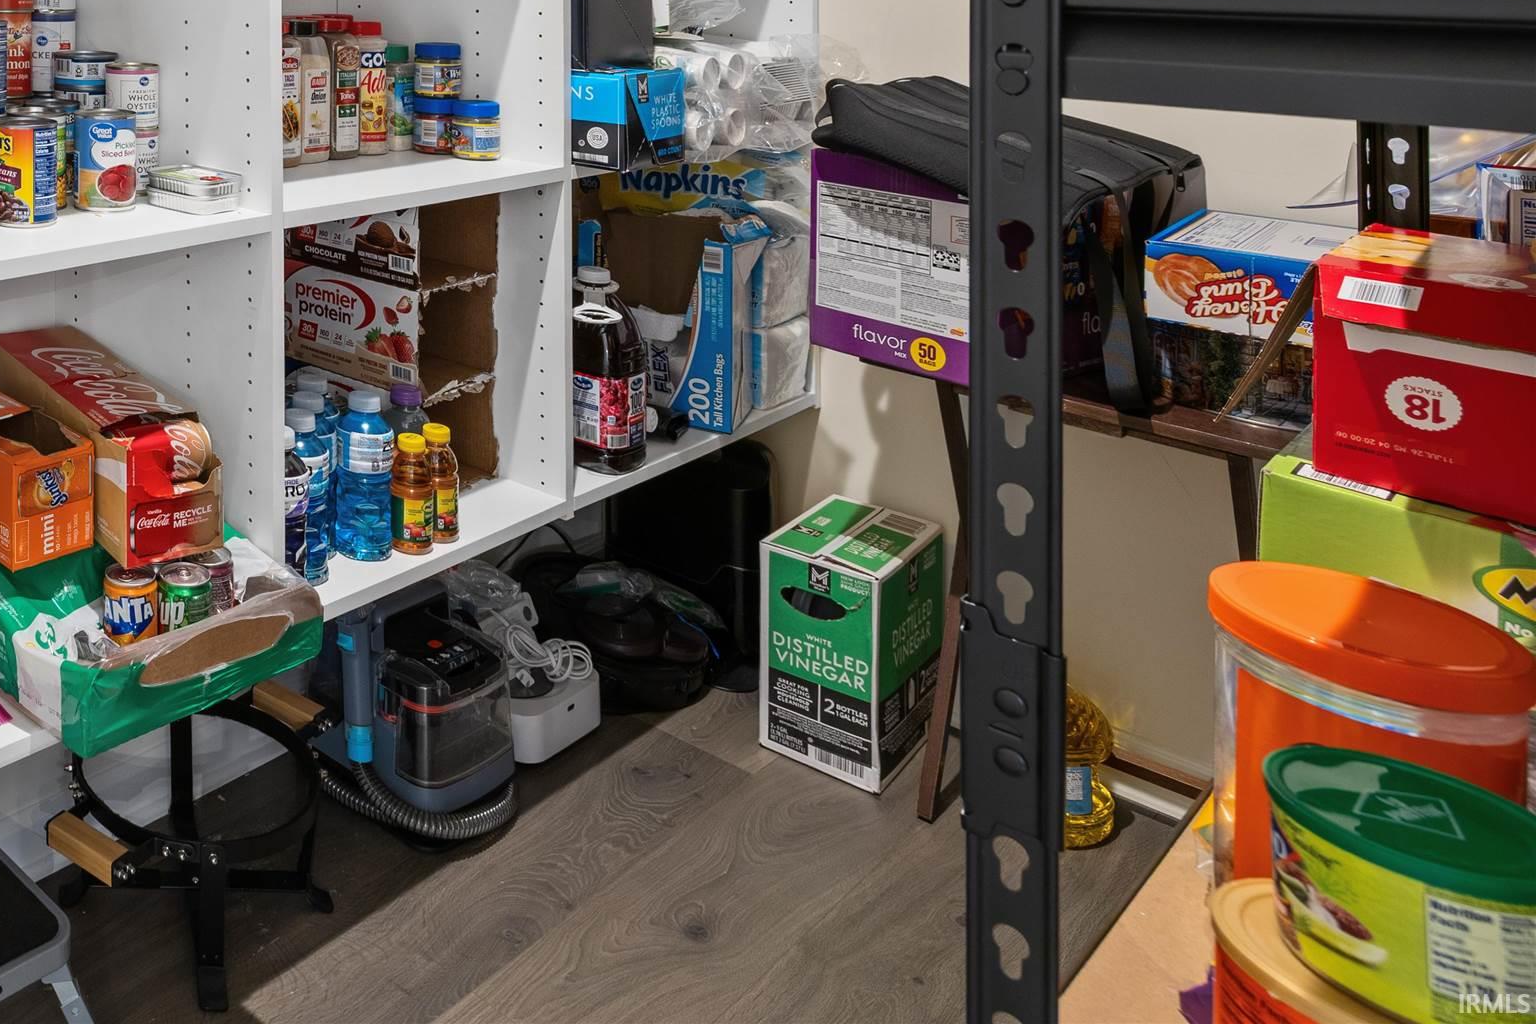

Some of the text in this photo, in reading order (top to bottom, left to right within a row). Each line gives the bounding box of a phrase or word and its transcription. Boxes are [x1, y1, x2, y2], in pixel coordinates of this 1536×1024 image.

[128, 93, 156, 103] WHOLE
[654, 95, 677, 104] WHITE
[651, 104, 679, 117] PLASTIC
[651, 115, 681, 129] SPOONS
[92, 126, 114, 136] Great
[101, 149, 121, 158] Sliced
[621, 169, 747, 199] Napkins
[304, 245, 347, 262] CHOCOLATE
[295, 282, 357, 310] premier
[1200, 278, 1278, 301] Buns
[299, 299, 352, 325] protein
[852, 324, 907, 350] flavor
[894, 350, 907, 359] MIX
[918, 343, 937, 361] 50
[919, 358, 936, 367] BAGS
[714, 353, 725, 427] Tall Kitchen Bags
[1402, 384, 1443, 397] STACKS
[688, 377, 710, 425] 200
[1403, 394, 1446, 424] 18
[173, 504, 213, 520] RECYCLE
[137, 515, 170, 530] Coca-Cola
[173, 518, 188, 529] ME
[43, 513, 55, 555] mini
[892, 599, 933, 649] DISTILLED
[805, 633, 832, 648] WHITE
[893, 621, 932, 668] VINEGAR
[773, 631, 869, 676] DISTILLED
[776, 648, 867, 693] VINEGAR
[776, 682, 811, 698] COOKING
[776, 695, 810, 712] CLEANING
[823, 698, 868, 720] 2 BOTTLES
